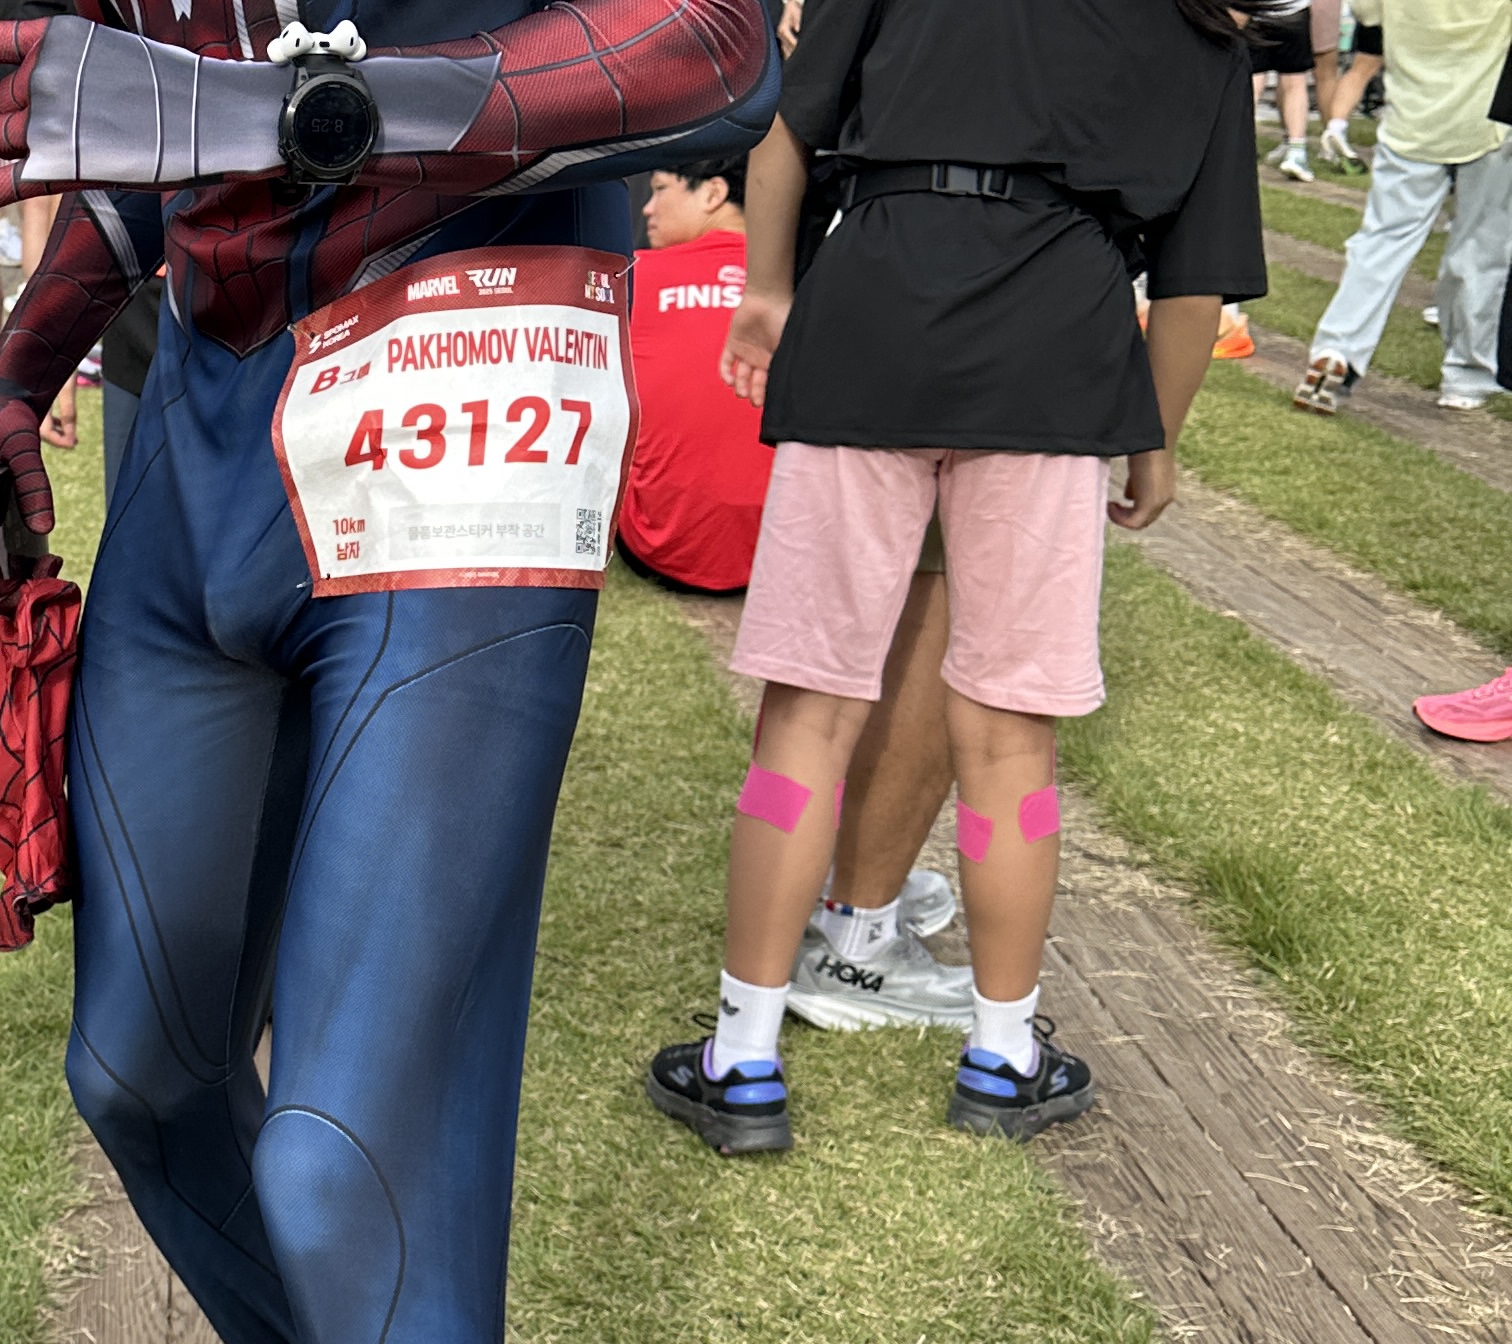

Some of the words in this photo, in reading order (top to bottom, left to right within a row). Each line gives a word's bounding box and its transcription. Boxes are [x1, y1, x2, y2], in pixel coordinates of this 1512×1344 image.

[407, 275, 460, 302] MARVEL
[465, 267, 517, 288] RUN
[388, 327, 518, 374] PAKHOMOV
[524, 326, 608, 370] VALENTIN
[344, 396, 592, 471] 43127
[332, 517, 366, 536] 10km
[337, 540, 361, 561] 남자
[815, 954, 884, 993] HOKA
